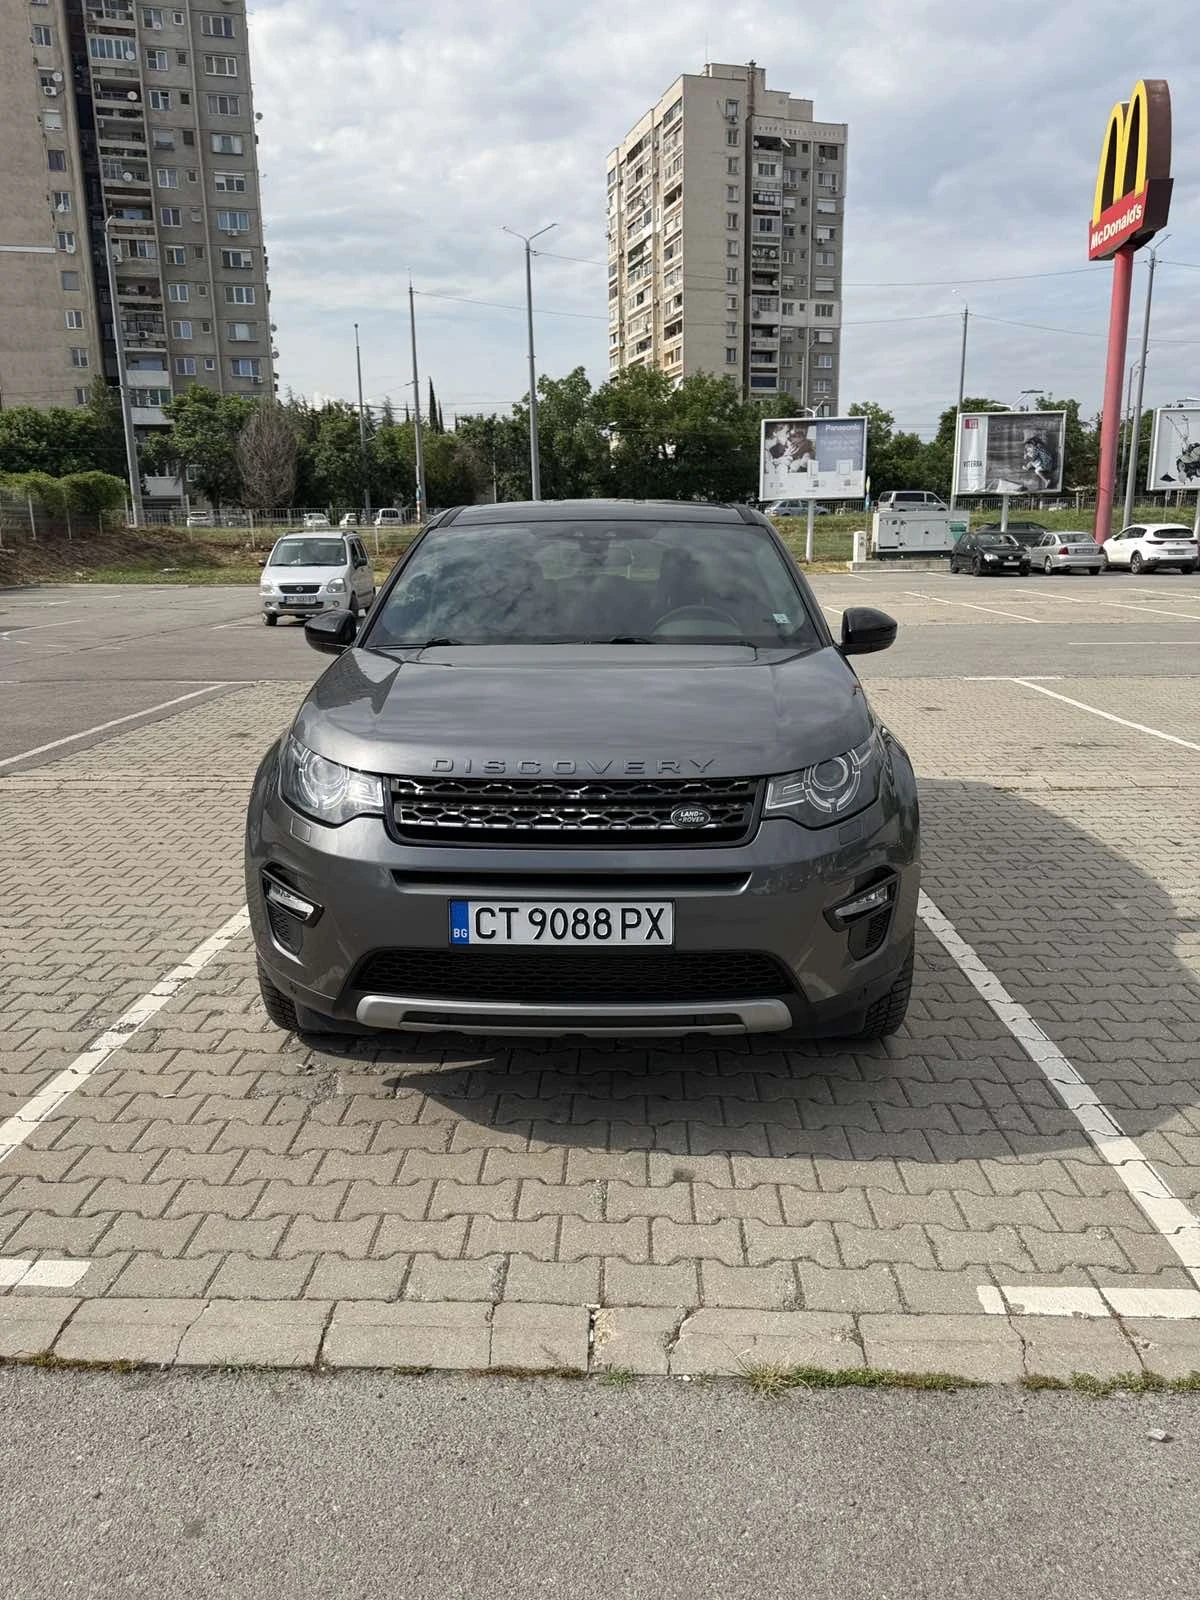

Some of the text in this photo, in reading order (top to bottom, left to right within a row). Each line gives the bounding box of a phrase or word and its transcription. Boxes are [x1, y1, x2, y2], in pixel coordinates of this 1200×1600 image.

[1090, 203, 1142, 250] McDonald's
[432, 758, 715, 776] DISCOVERY
[453, 928, 467, 938] BG
[475, 907, 665, 940] CT 9088 PX
